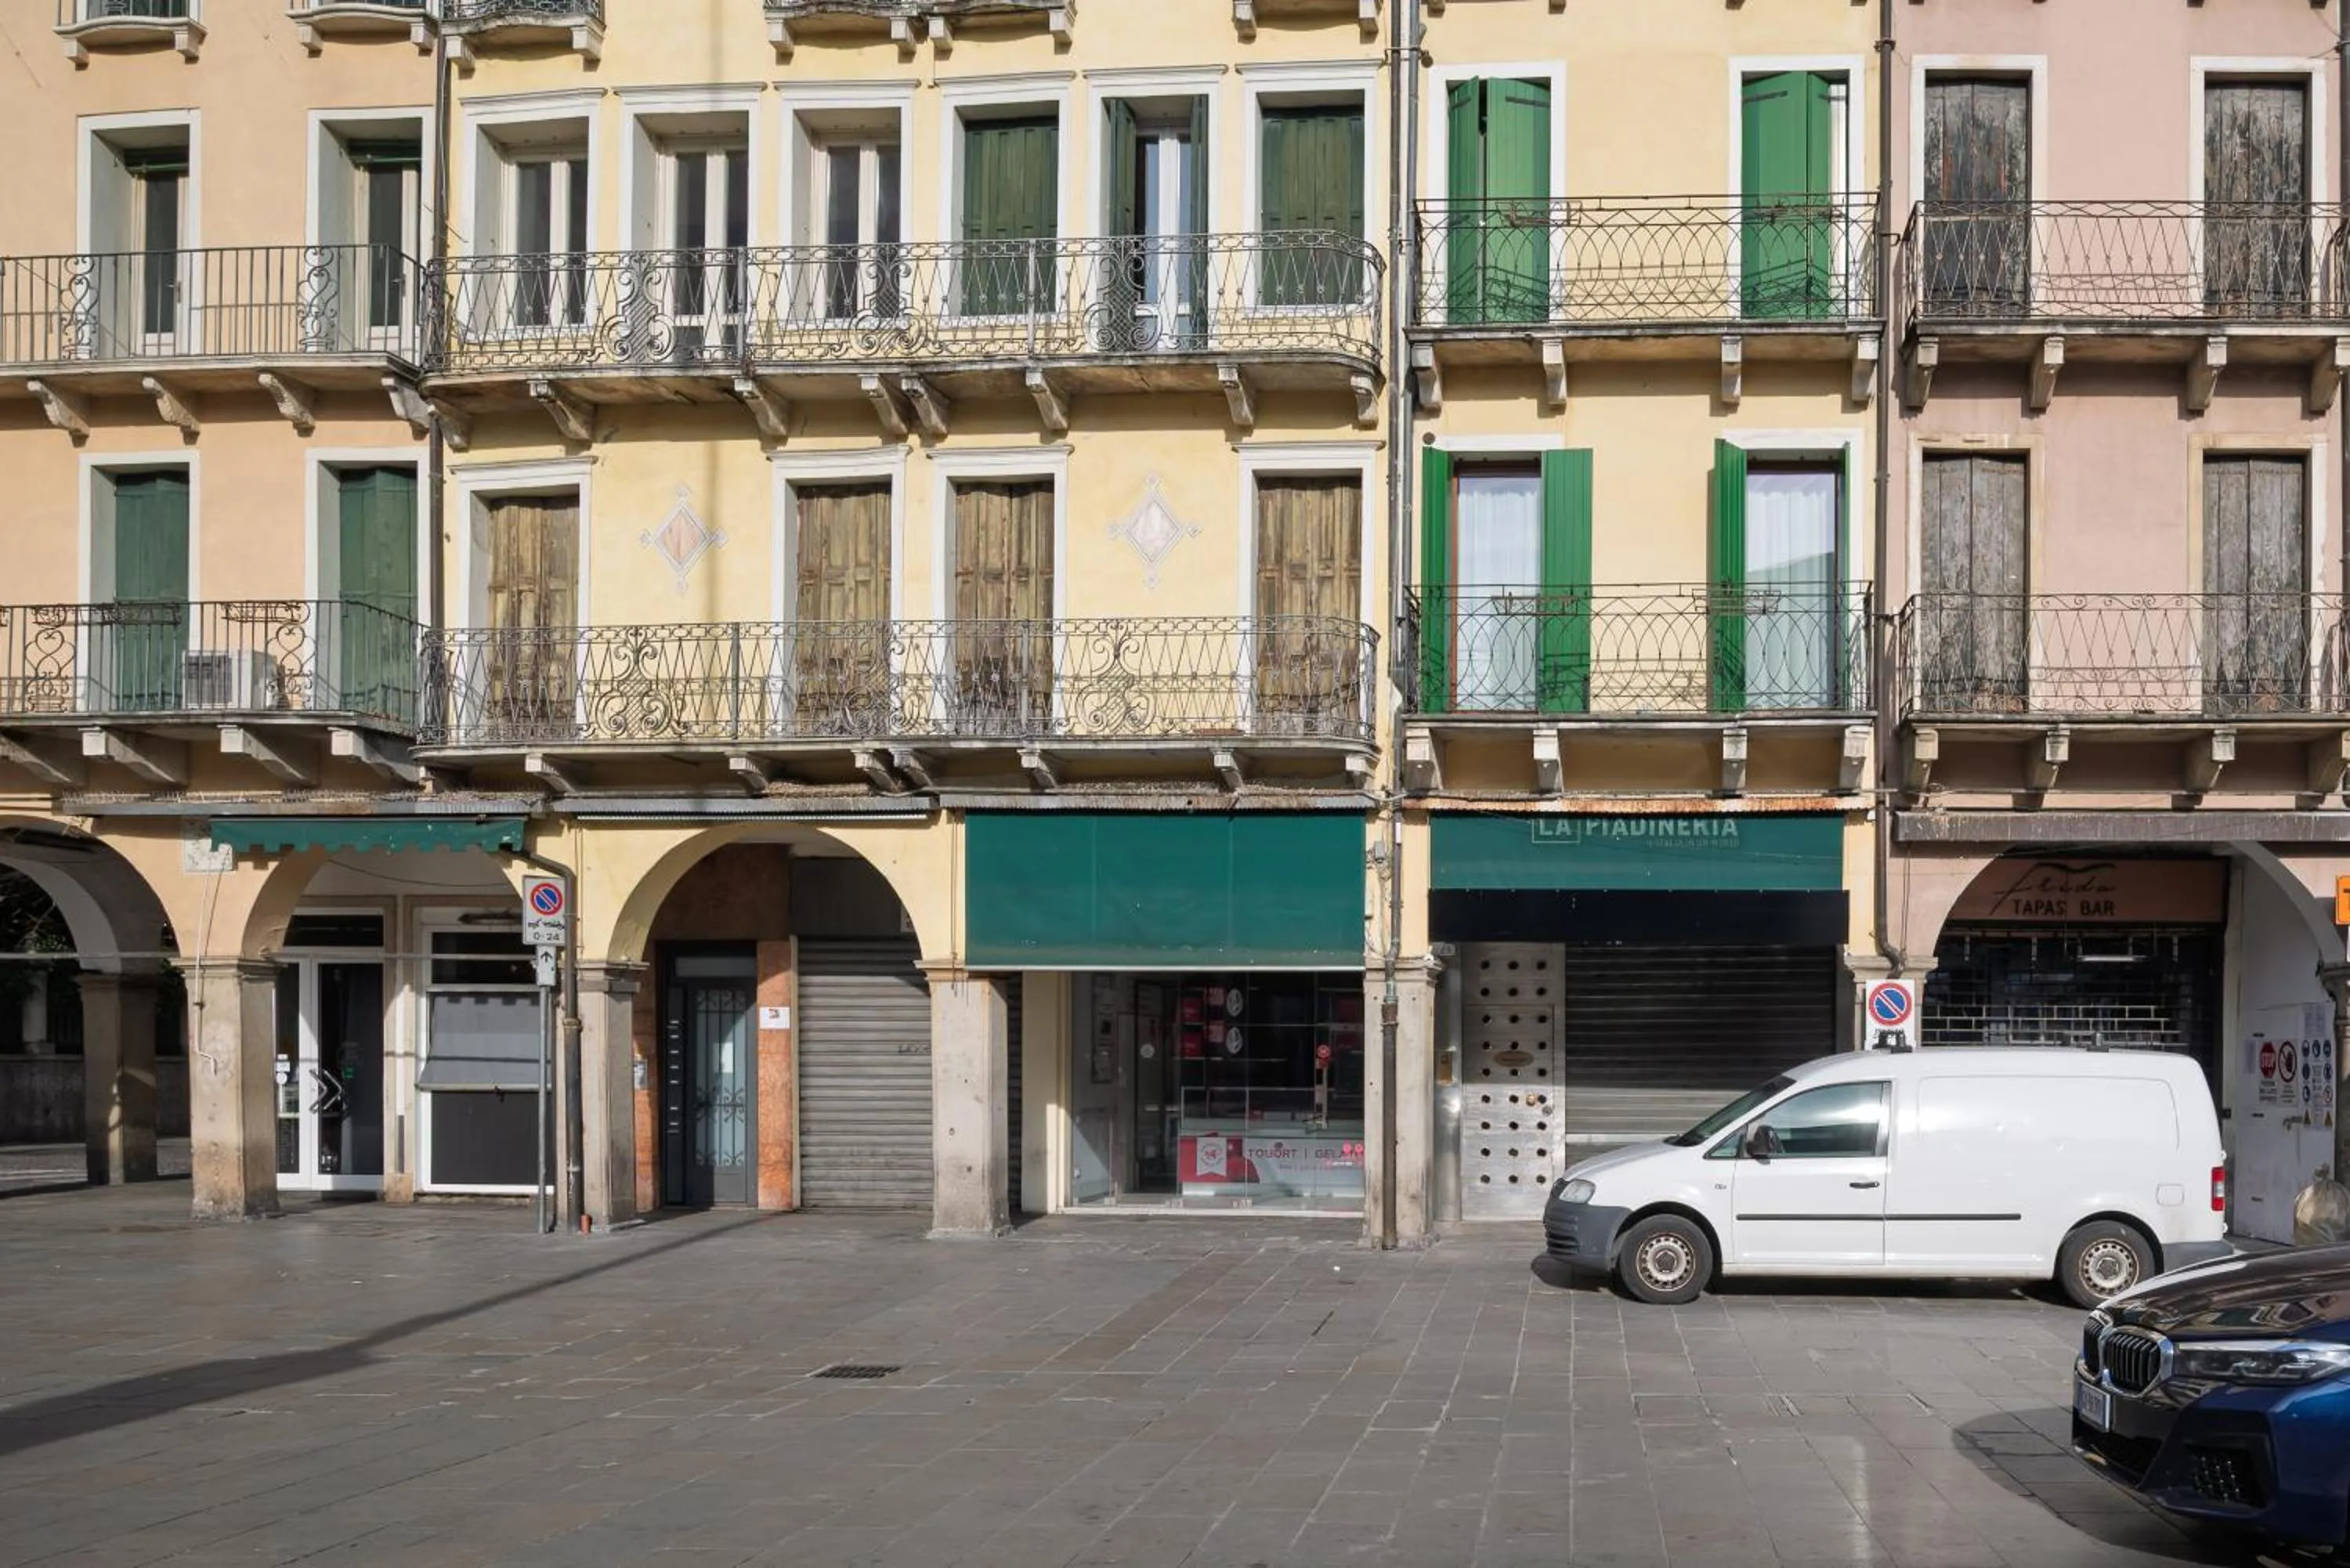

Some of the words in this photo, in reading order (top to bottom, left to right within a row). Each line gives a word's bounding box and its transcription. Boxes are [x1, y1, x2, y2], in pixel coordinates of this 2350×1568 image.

[1539, 818, 1572, 836] LA
[2013, 899, 2066, 916] TAPAS
[2080, 899, 2115, 916] BAR
